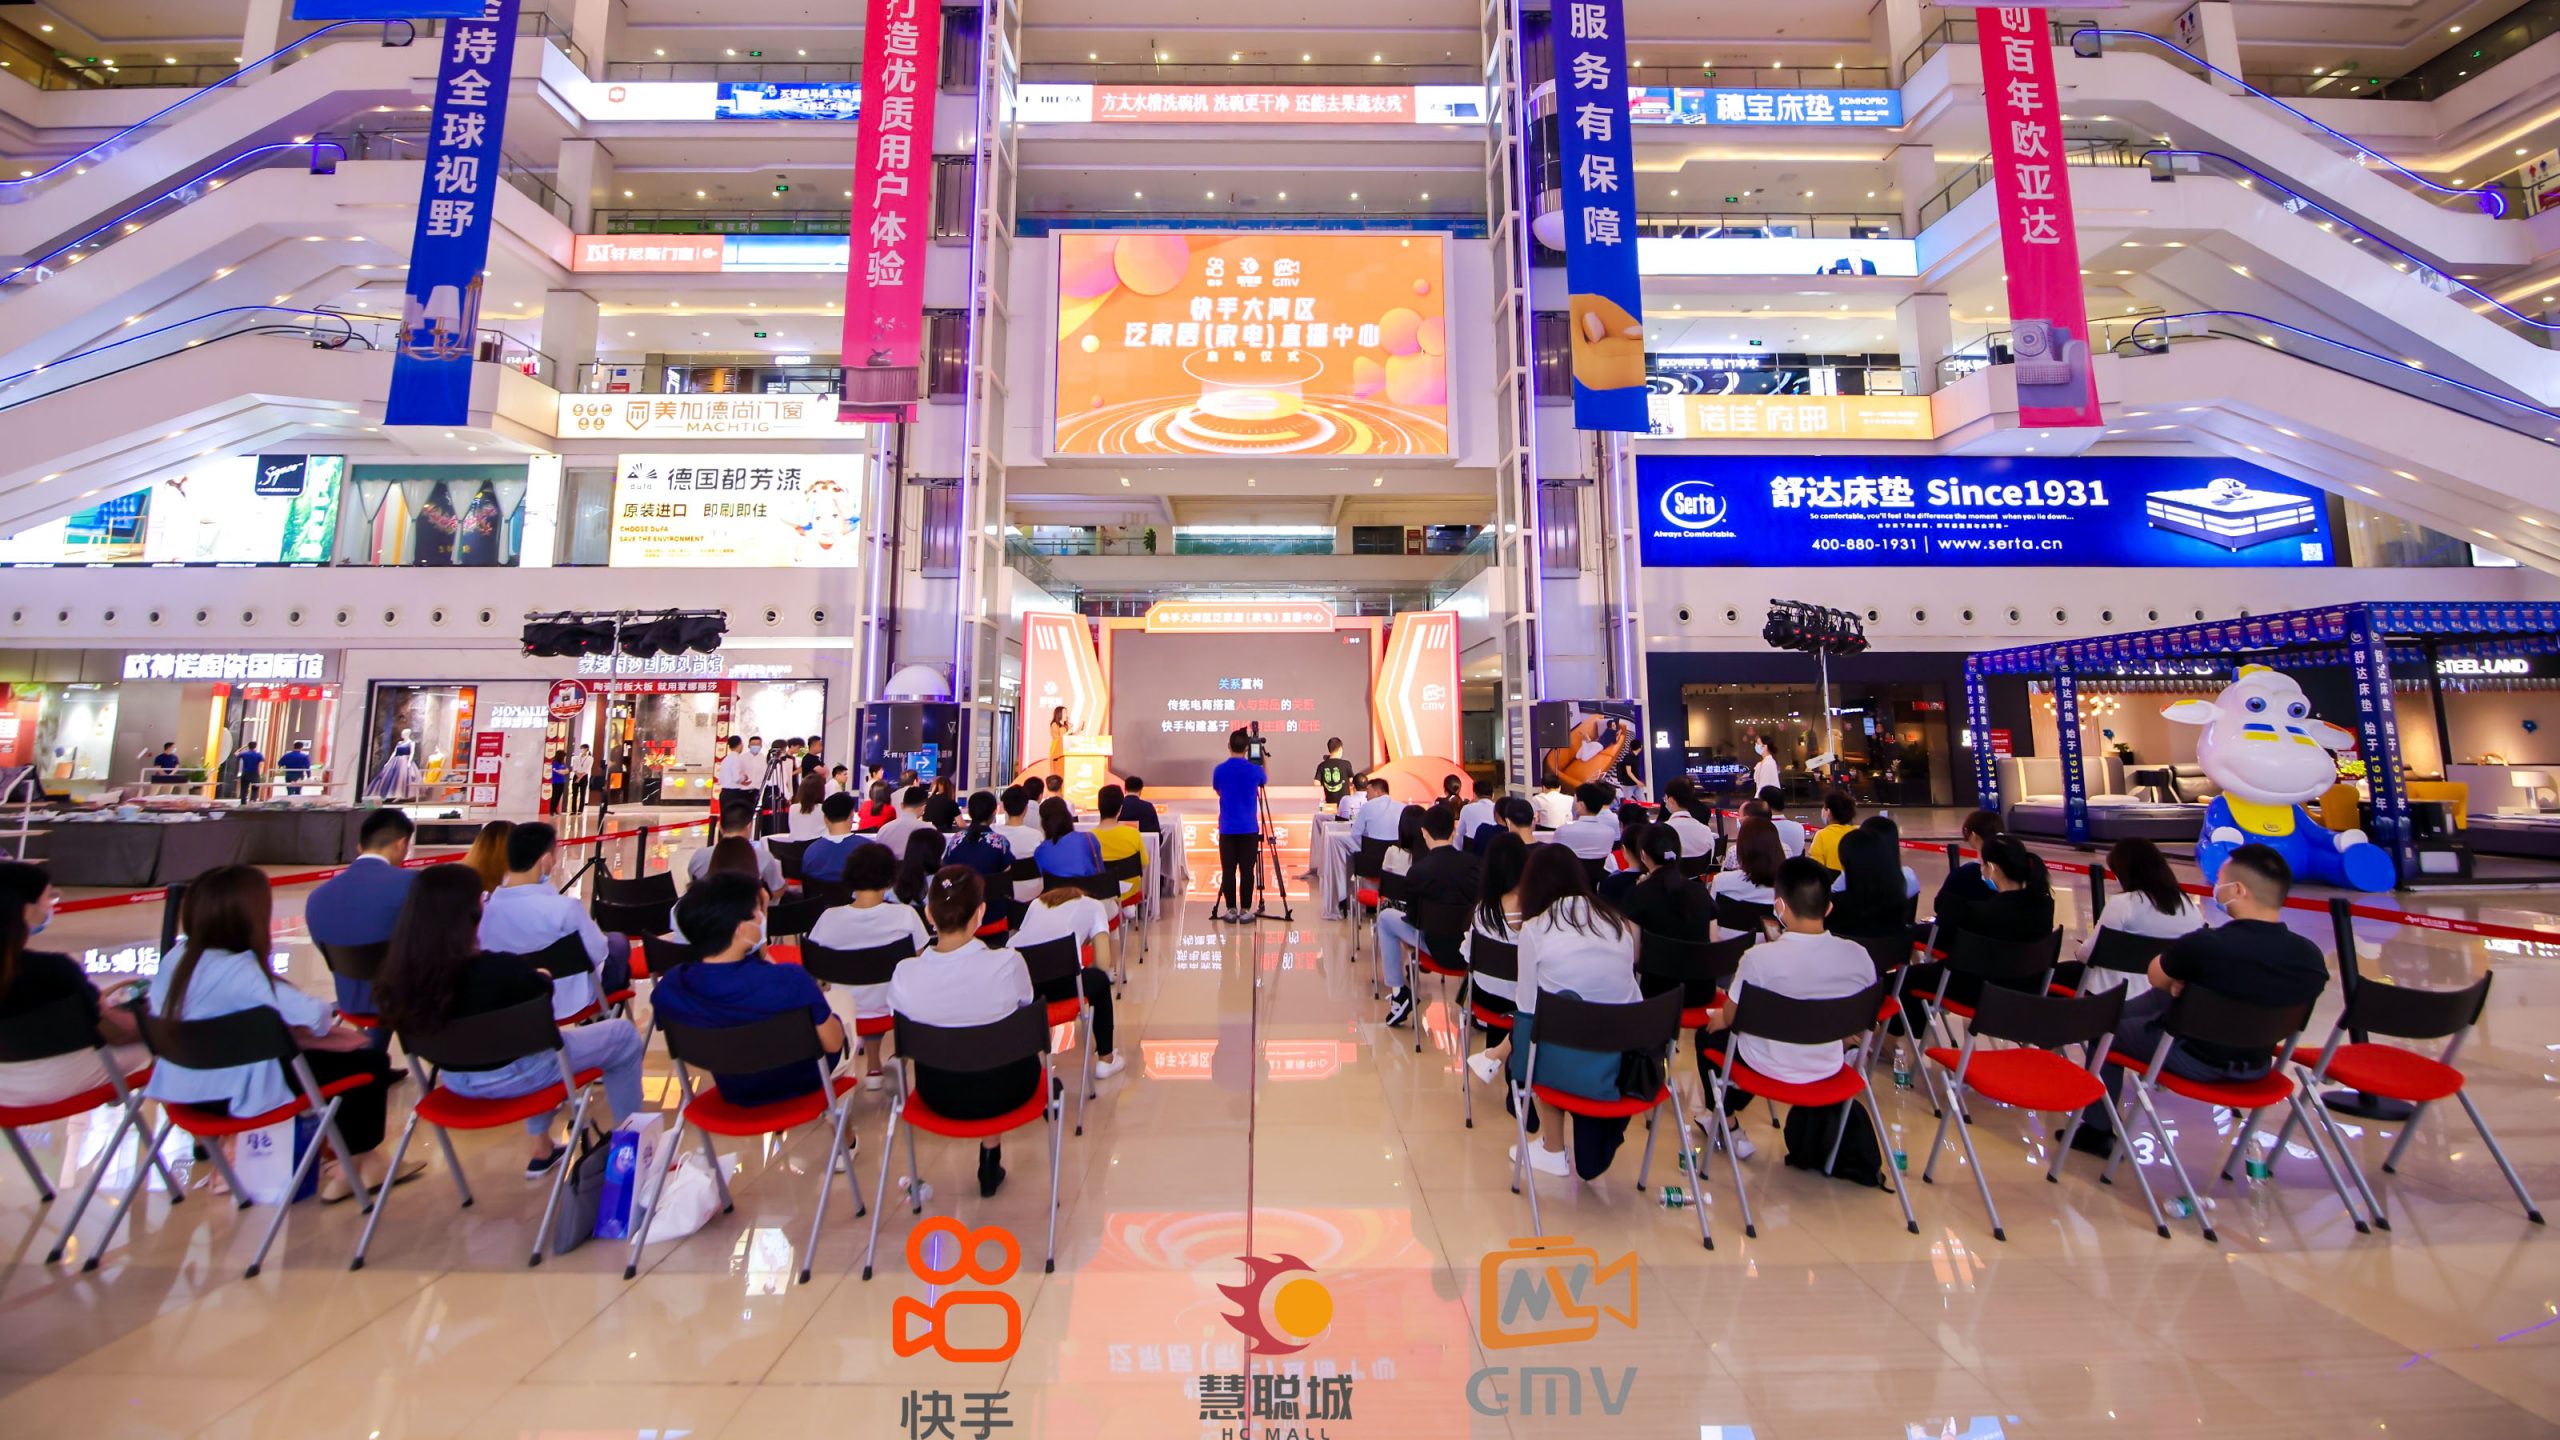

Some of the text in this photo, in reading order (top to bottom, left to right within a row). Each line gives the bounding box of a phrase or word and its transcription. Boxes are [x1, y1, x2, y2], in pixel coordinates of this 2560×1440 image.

[1213, 93, 1291, 112] 洗碗更干净
[1570, 2, 1622, 247] 服务有保障
[1998, 7, 2061, 245] 创百年欧亚达
[866, 0, 921, 288] 打造优质用户体验
[1190, 296, 1317, 321] 快手大湾区
[655, 401, 804, 420] 美加德尚门窗
[687, 422, 770, 432] MACHTIG
[667, 468, 802, 490] 德国都芳漆
[1675, 491, 1716, 516] Serta
[1770, 476, 2109, 508] 舒达床垫 Since1931
[623, 503, 768, 518] 原装进口 即刷即住
[1917, 512, 1953, 521] difference
[1968, 512, 1998, 521] moment
[2002, 512, 2022, 521] when
[1653, 529, 1737, 539] Always Comfortable.
[1812, 537, 2064, 551] 400-880-1931 www.serta.cn
[122, 653, 324, 679] 欧神诺陶瓷国际馆
[1219, 678, 1264, 690] 关系重构
[2061, 676, 2081, 793] 舒达床垫 始于1931年
[2354, 650, 2388, 811] 舒达床垫 始于1931年
